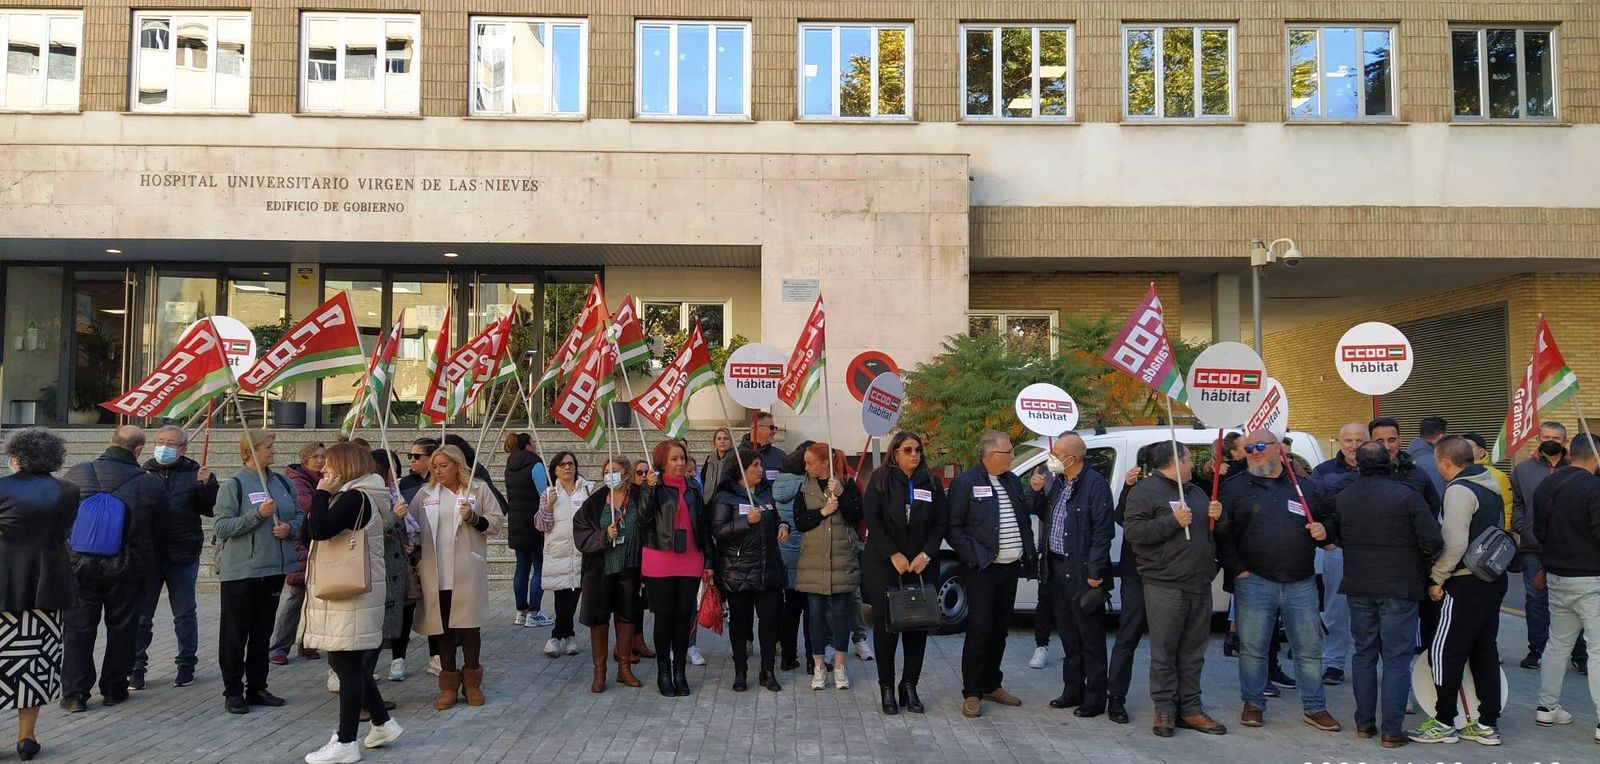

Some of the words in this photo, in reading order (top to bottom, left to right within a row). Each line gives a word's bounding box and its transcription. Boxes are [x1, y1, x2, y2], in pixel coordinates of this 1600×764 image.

[140, 174, 218, 188] HOSPITAL
[227, 175, 349, 190] UNIVERSITARIO
[358, 178, 415, 191] VIRGEN
[422, 179, 442, 192] DE
[449, 179, 477, 192] LAS
[485, 179, 539, 192] NIEVES
[266, 200, 319, 212] EDIFICIO
[323, 201, 339, 212] DE
[343, 201, 405, 213] GOBIERNO
[1344, 348, 1387, 358] CCOO
[732, 366, 767, 376] CCOO
[1351, 361, 1399, 373] hábitat
[736, 378, 777, 389] hábitat
[1197, 373, 1241, 385] CCOO
[1201, 389, 1251, 403] hábitat
[1023, 400, 1057, 409] CCOO
[1028, 411, 1067, 421] hábitat
[1262, 406, 1282, 431] bitat
